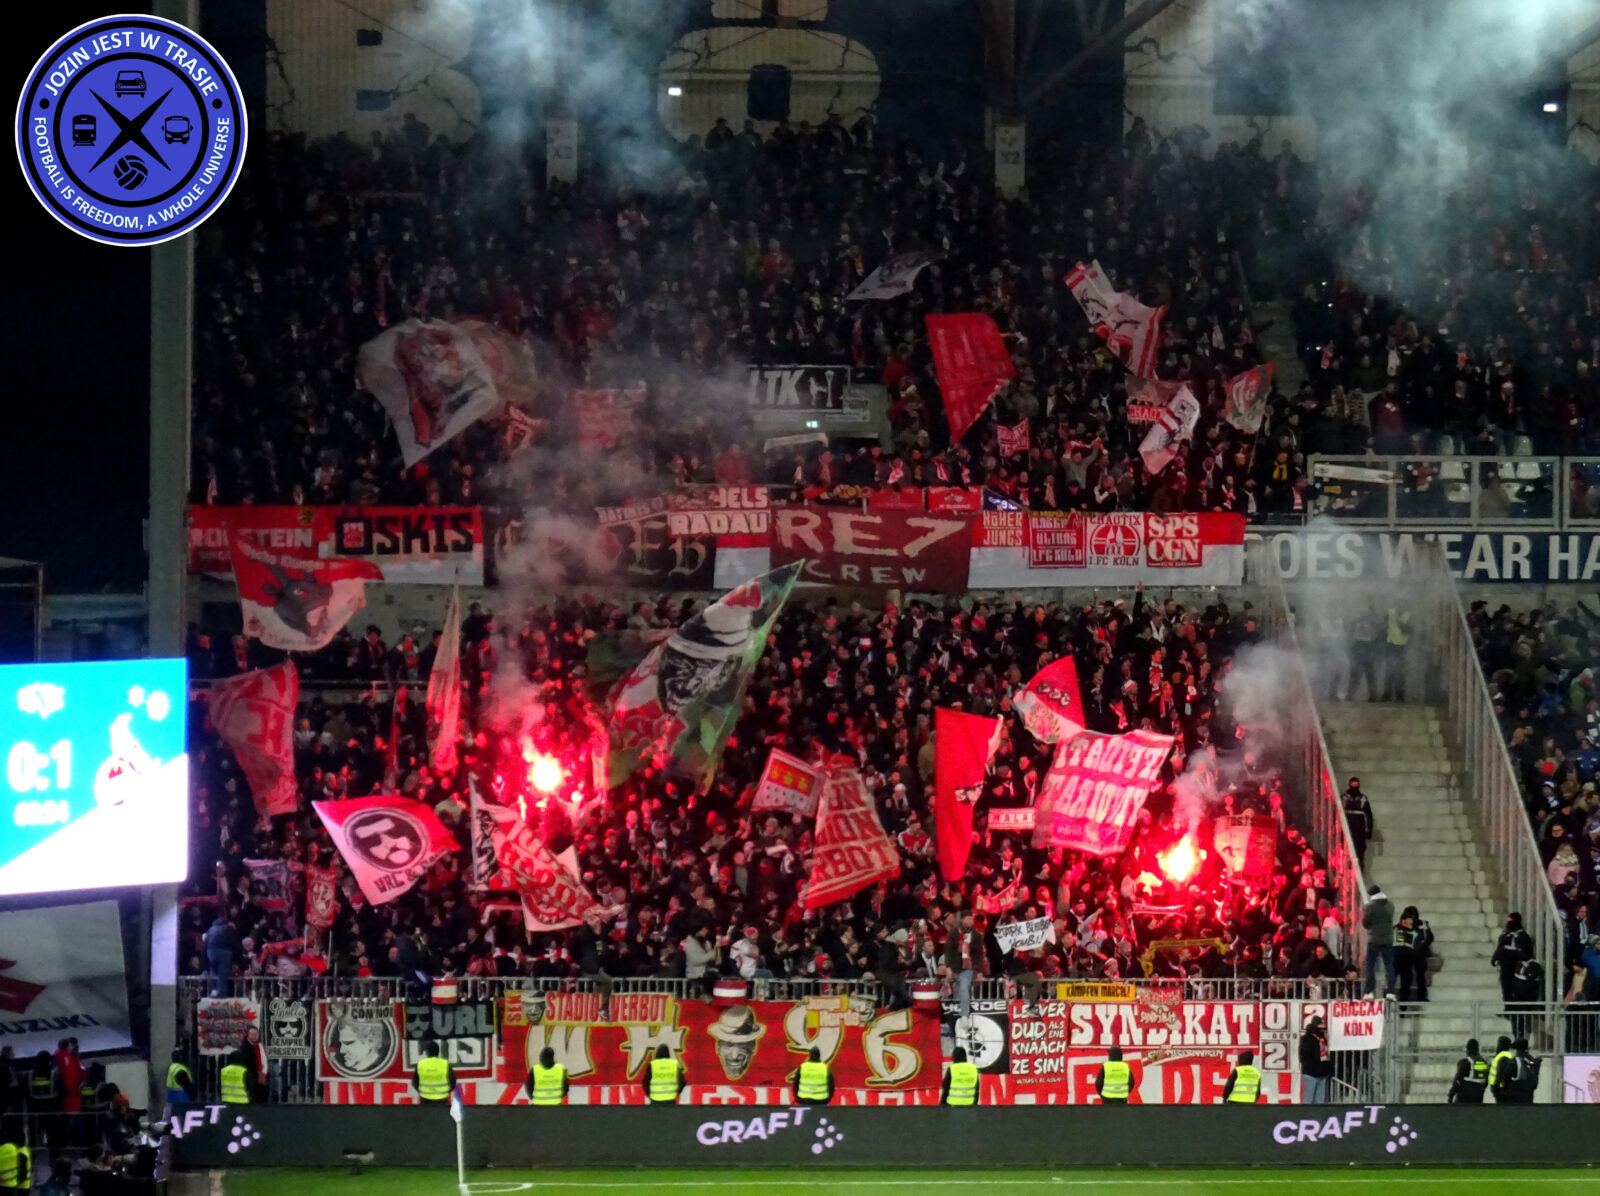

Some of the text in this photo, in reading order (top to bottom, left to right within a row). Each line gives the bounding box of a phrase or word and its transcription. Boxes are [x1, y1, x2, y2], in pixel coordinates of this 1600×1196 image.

[671, 513, 768, 536] RADAU
[1148, 515, 1199, 538] SPS
[1148, 538, 1200, 561] CGN
[1378, 532, 1532, 580] WEAR
[7, 738, 72, 793] 0:1
[431, 1004, 494, 1037] URL
[1012, 1002, 1067, 1020] LEVER
[0, 1013, 101, 1035] UZUKI
[1011, 1022, 1046, 1041] DUD
[1343, 1018, 1374, 1037] KÖLN
[1011, 1059, 1030, 1075] ZE
[696, 1106, 812, 1146] CRAFT
[1272, 1105, 1386, 1145] CRAFT
